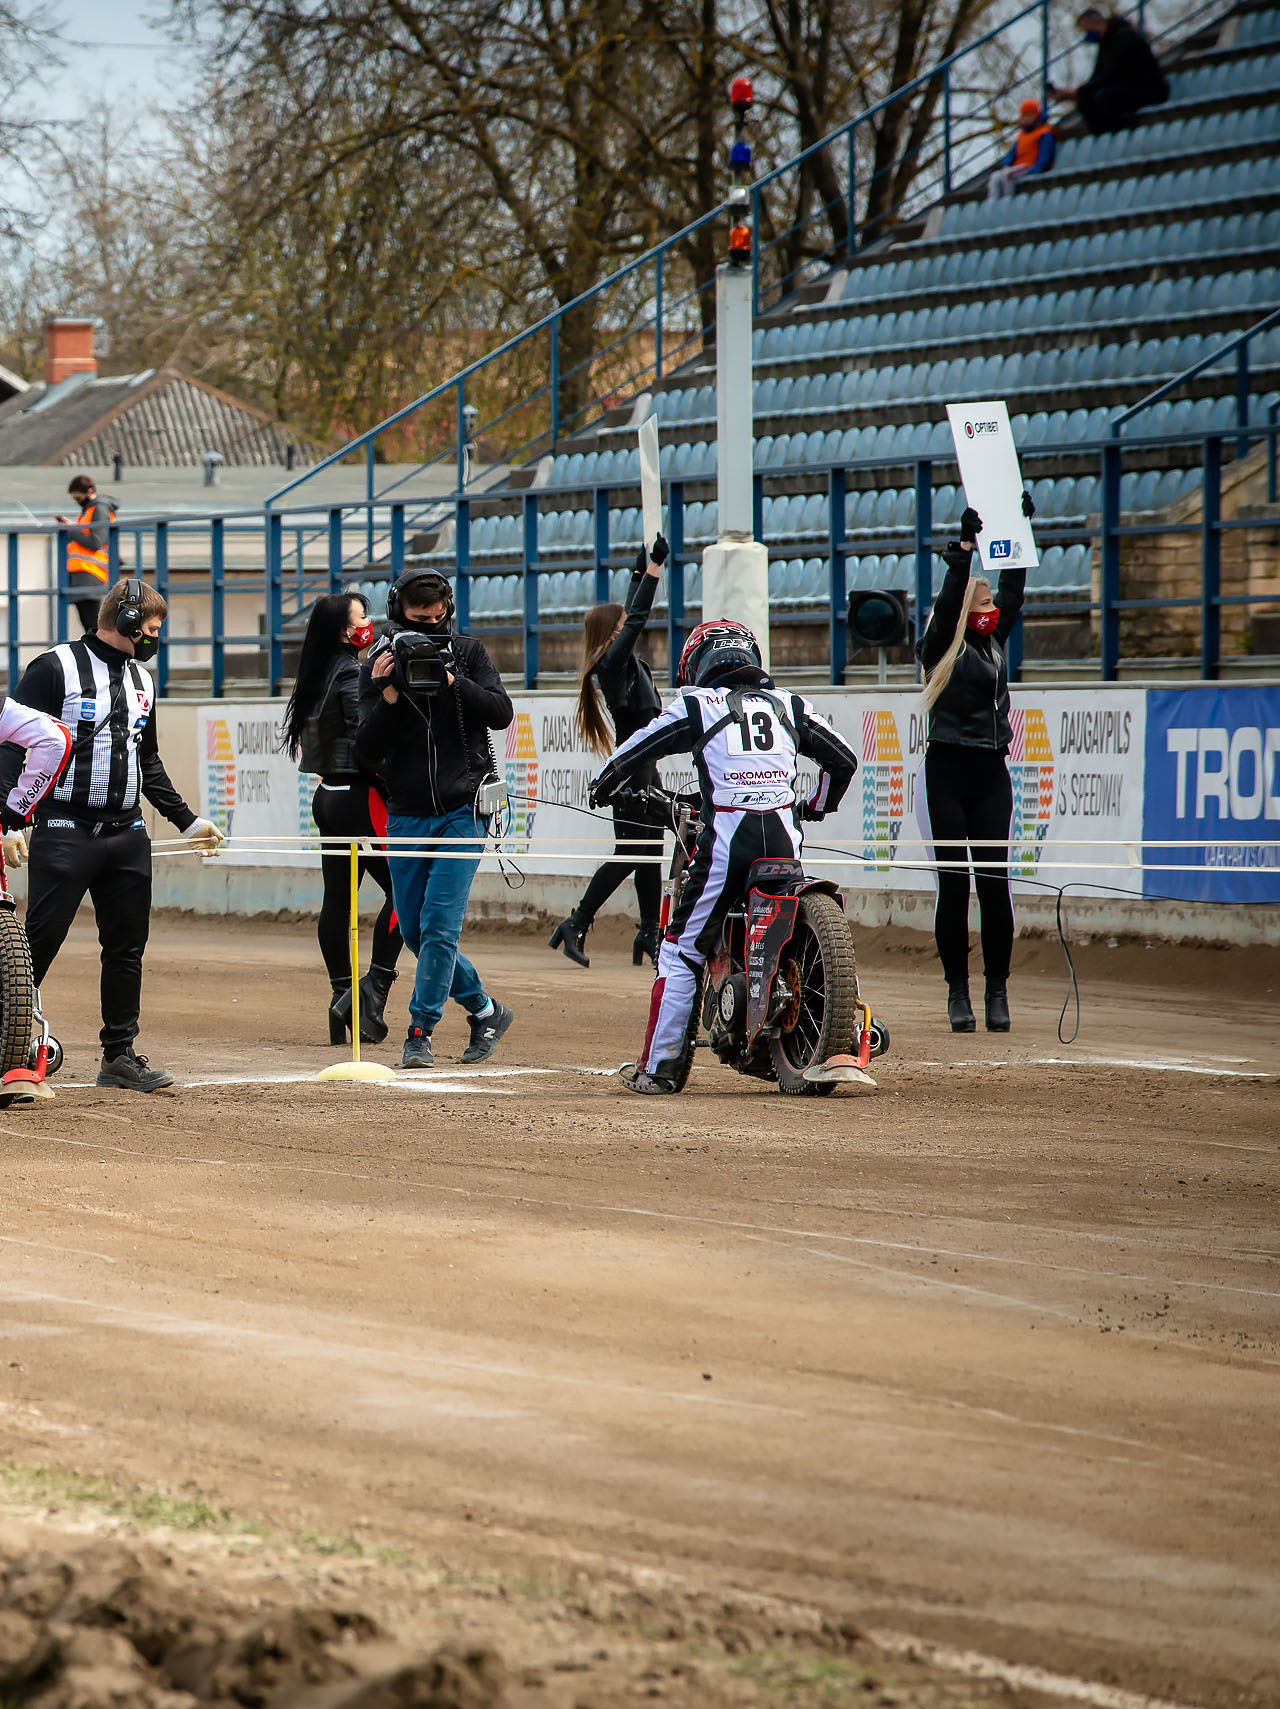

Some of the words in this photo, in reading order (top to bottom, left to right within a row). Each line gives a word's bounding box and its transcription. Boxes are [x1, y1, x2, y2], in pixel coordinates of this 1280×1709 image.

[975, 421, 1000, 434] OPTIBET
[740, 712, 774, 751] 13
[1060, 711, 1132, 755] DAUGAVPILS
[29, 771, 52, 799] Trans
[723, 771, 789, 781] LOKOMOTIV
[1055, 774, 1068, 815] IS
[1070, 774, 1124, 816] SPEEDWAY
